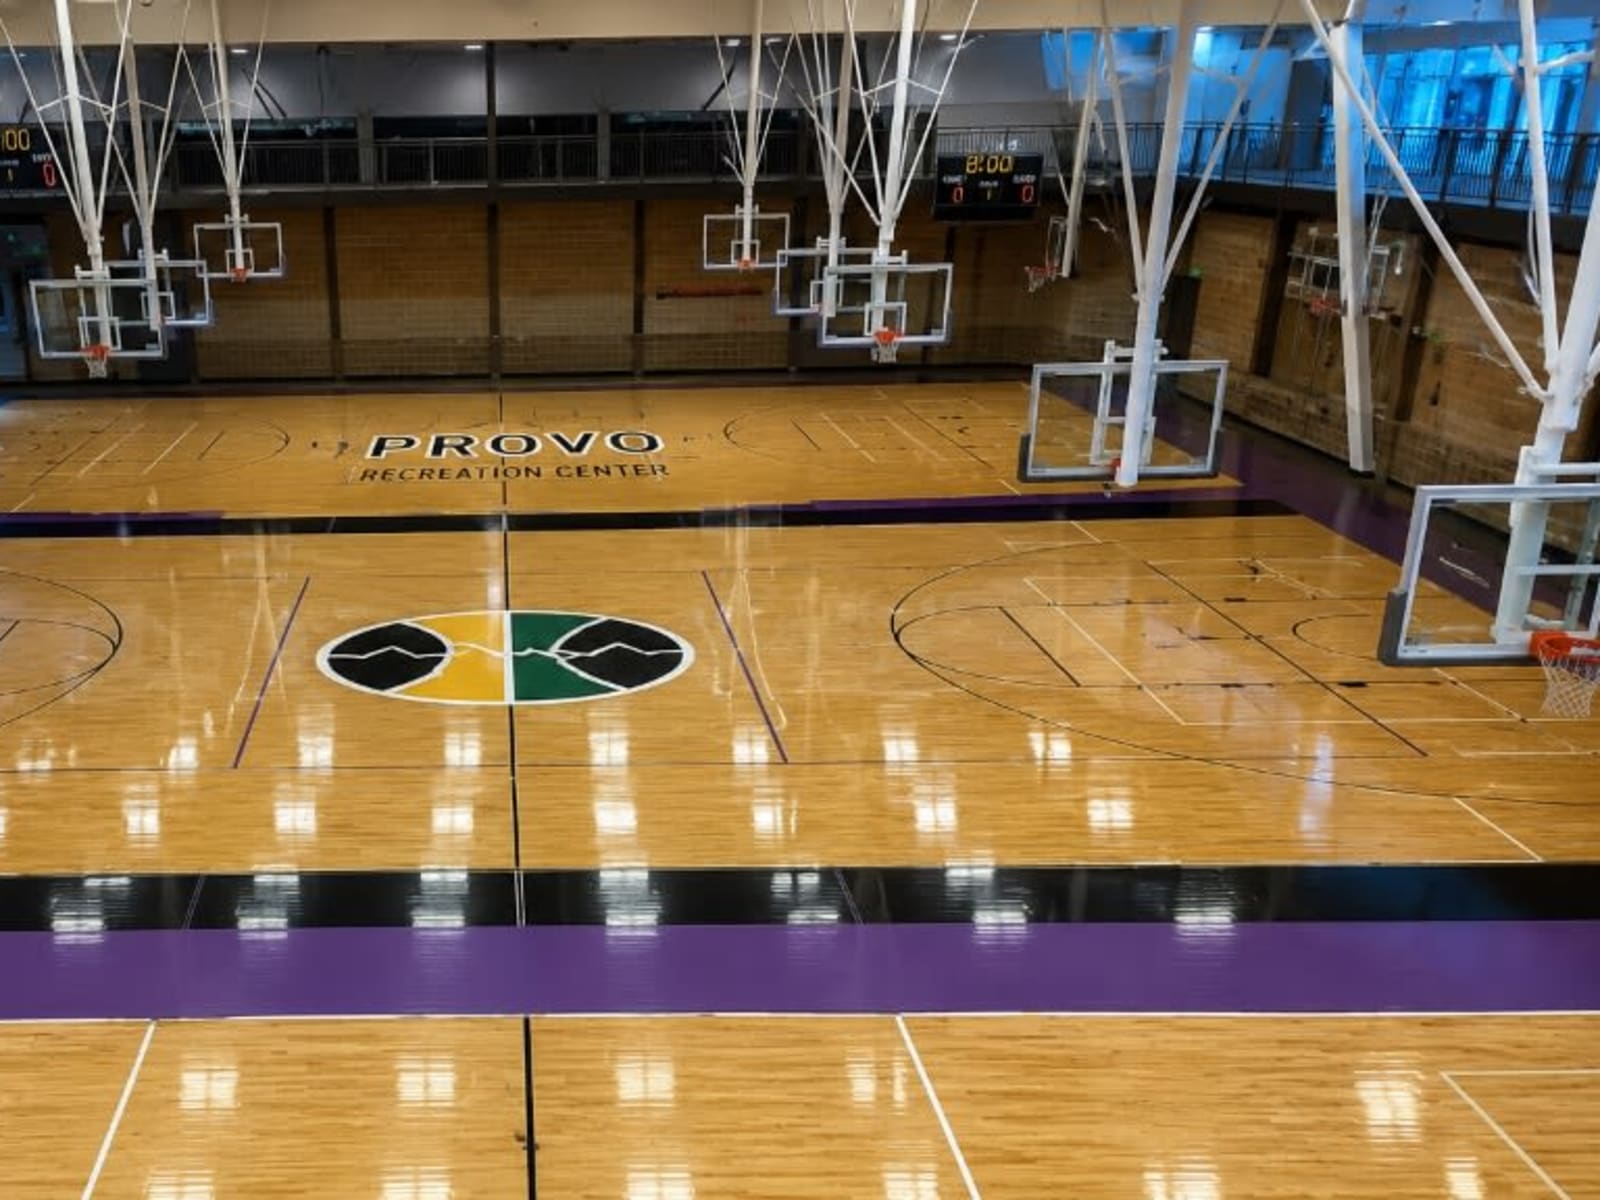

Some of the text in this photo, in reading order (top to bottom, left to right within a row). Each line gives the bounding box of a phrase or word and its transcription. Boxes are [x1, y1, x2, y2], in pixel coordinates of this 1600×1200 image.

[43, 163, 56, 186] 0
[953, 186, 963, 203] 0
[1022, 185, 1034, 203] 0
[365, 431, 665, 459] PROVO
[360, 463, 669, 482] RECREATION CENTER
